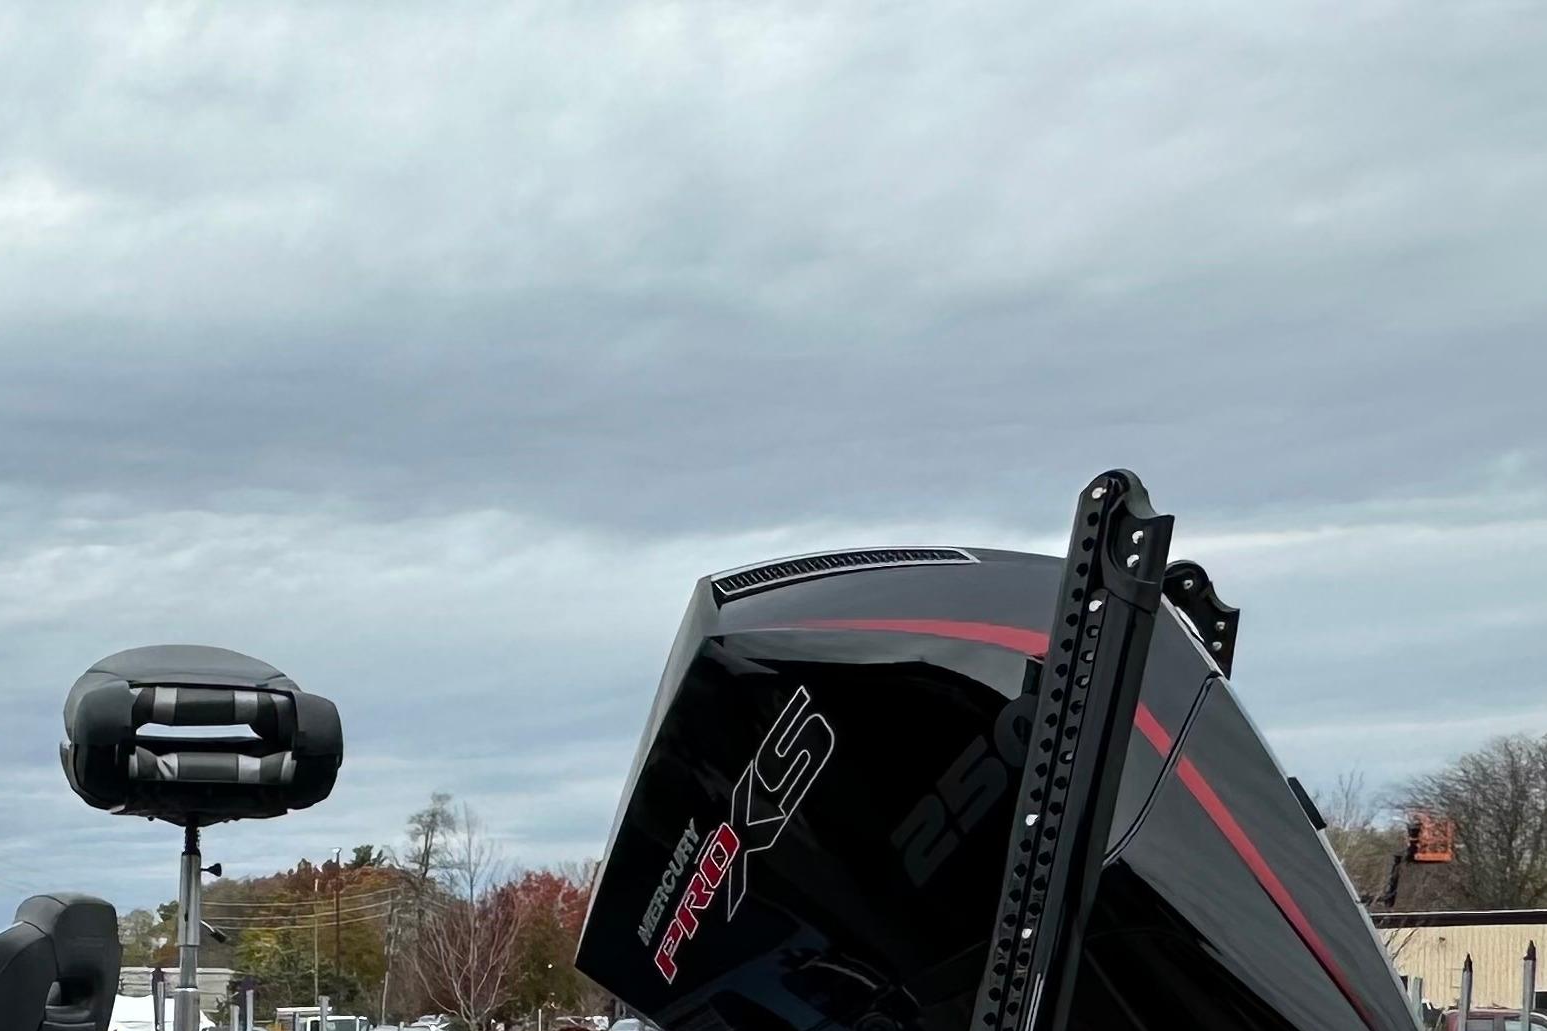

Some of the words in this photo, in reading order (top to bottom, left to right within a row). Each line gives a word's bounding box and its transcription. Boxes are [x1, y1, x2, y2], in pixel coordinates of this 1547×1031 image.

[637, 817, 700, 946] MERCURY
[695, 685, 835, 922] XS
[655, 822, 740, 984] PRO
